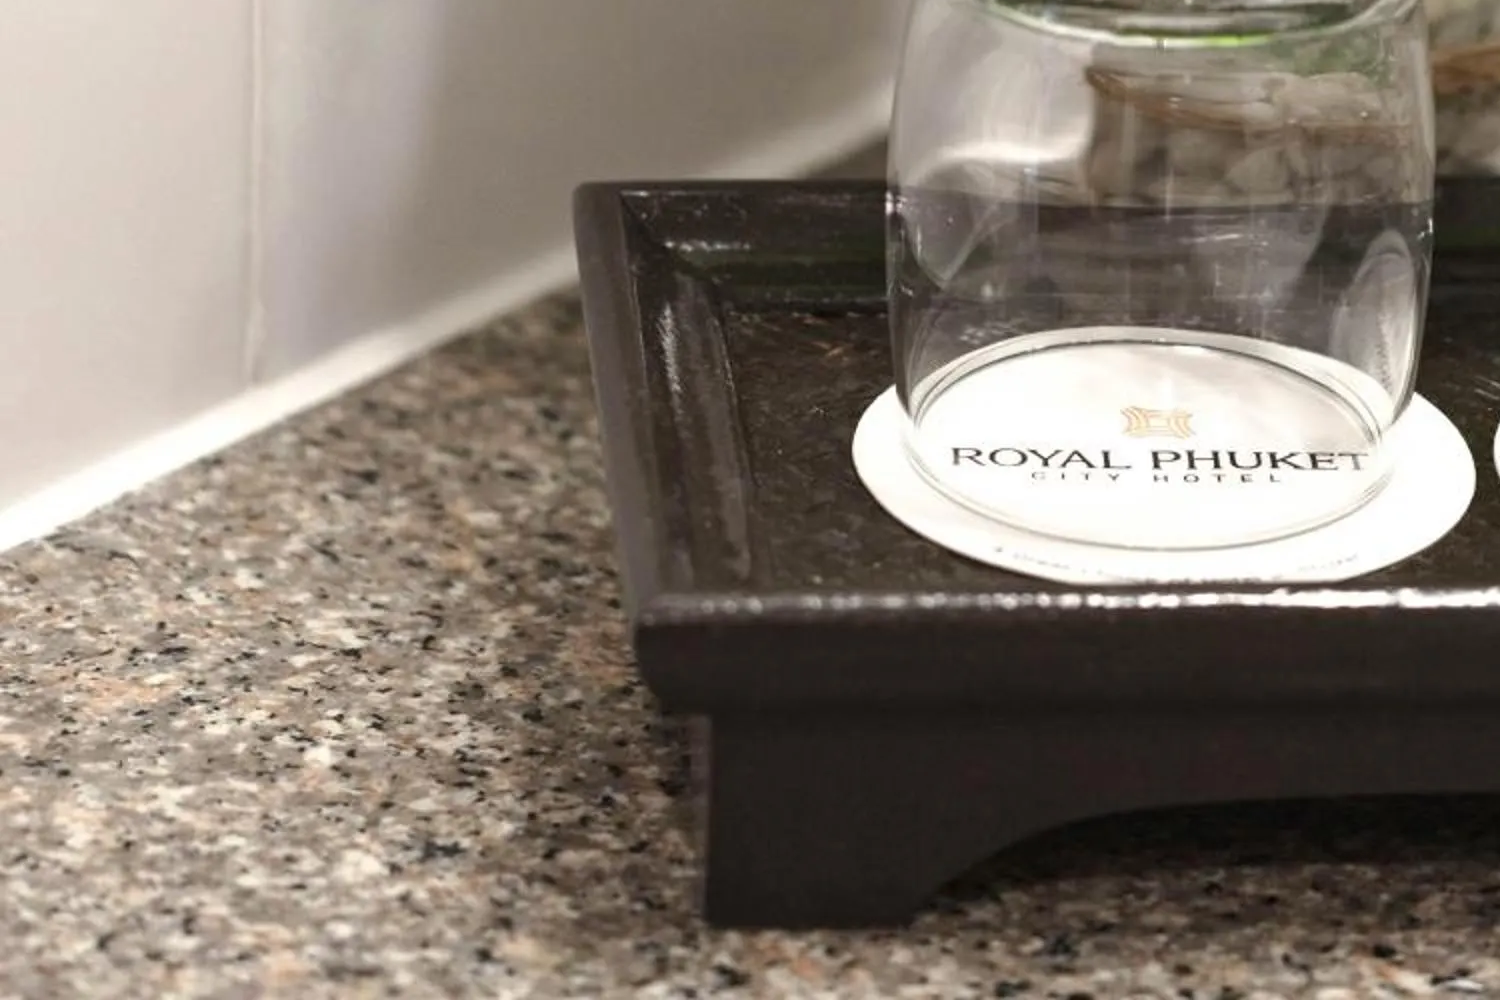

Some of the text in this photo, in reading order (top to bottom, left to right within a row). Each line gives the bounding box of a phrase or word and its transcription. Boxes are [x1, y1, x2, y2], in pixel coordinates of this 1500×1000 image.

[951, 447, 1369, 471] ROYAL PHUKET
[1031, 471, 1281, 483] CITY HOTEL
